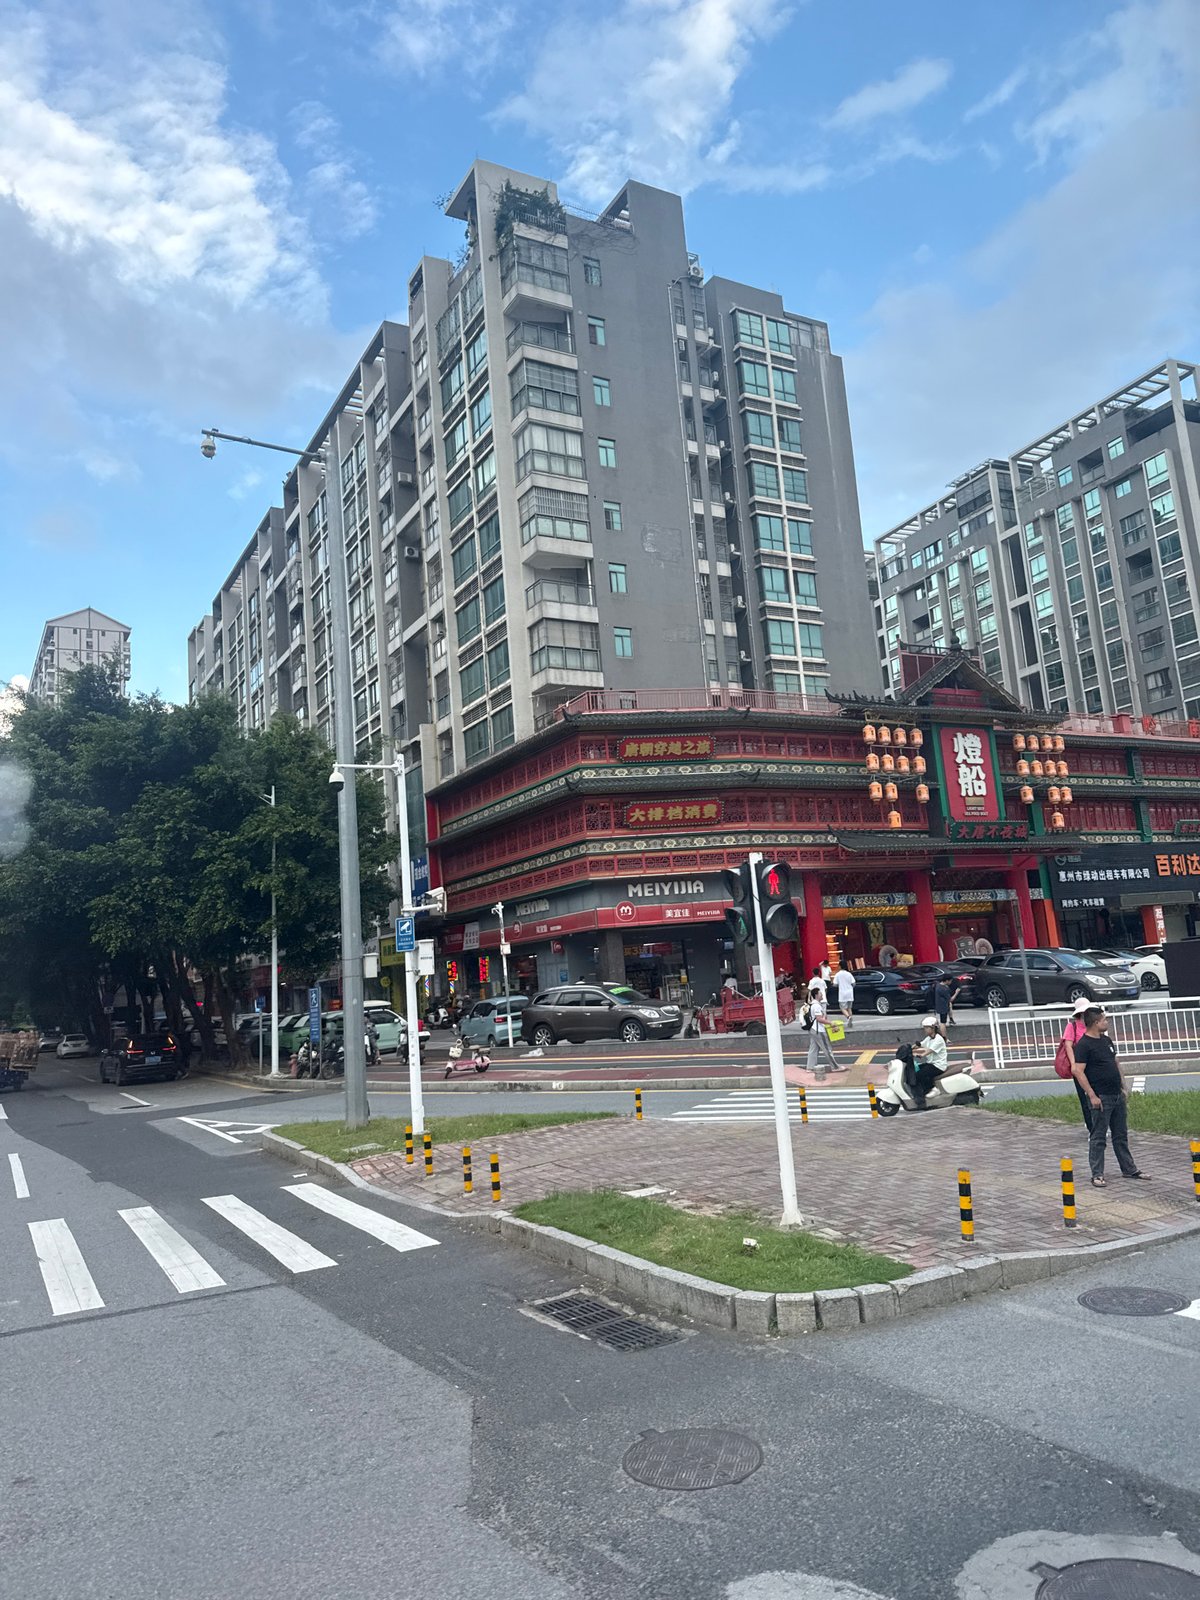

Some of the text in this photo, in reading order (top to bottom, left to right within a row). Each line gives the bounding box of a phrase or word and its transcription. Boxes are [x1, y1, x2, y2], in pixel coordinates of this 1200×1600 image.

[624, 741, 711, 757] 唐朝穿越之旅
[953, 732, 987, 796] 燈船
[629, 803, 717, 822] 大排档消费
[957, 825, 1027, 839] 大唐不夜城
[1155, 853, 1200, 876] 百利达
[1058, 868, 1150, 882] 惠州市绿动出租车有限公司
[628, 880, 704, 897] MEIYIJIA
[665, 908, 690, 918] 美宜佳
